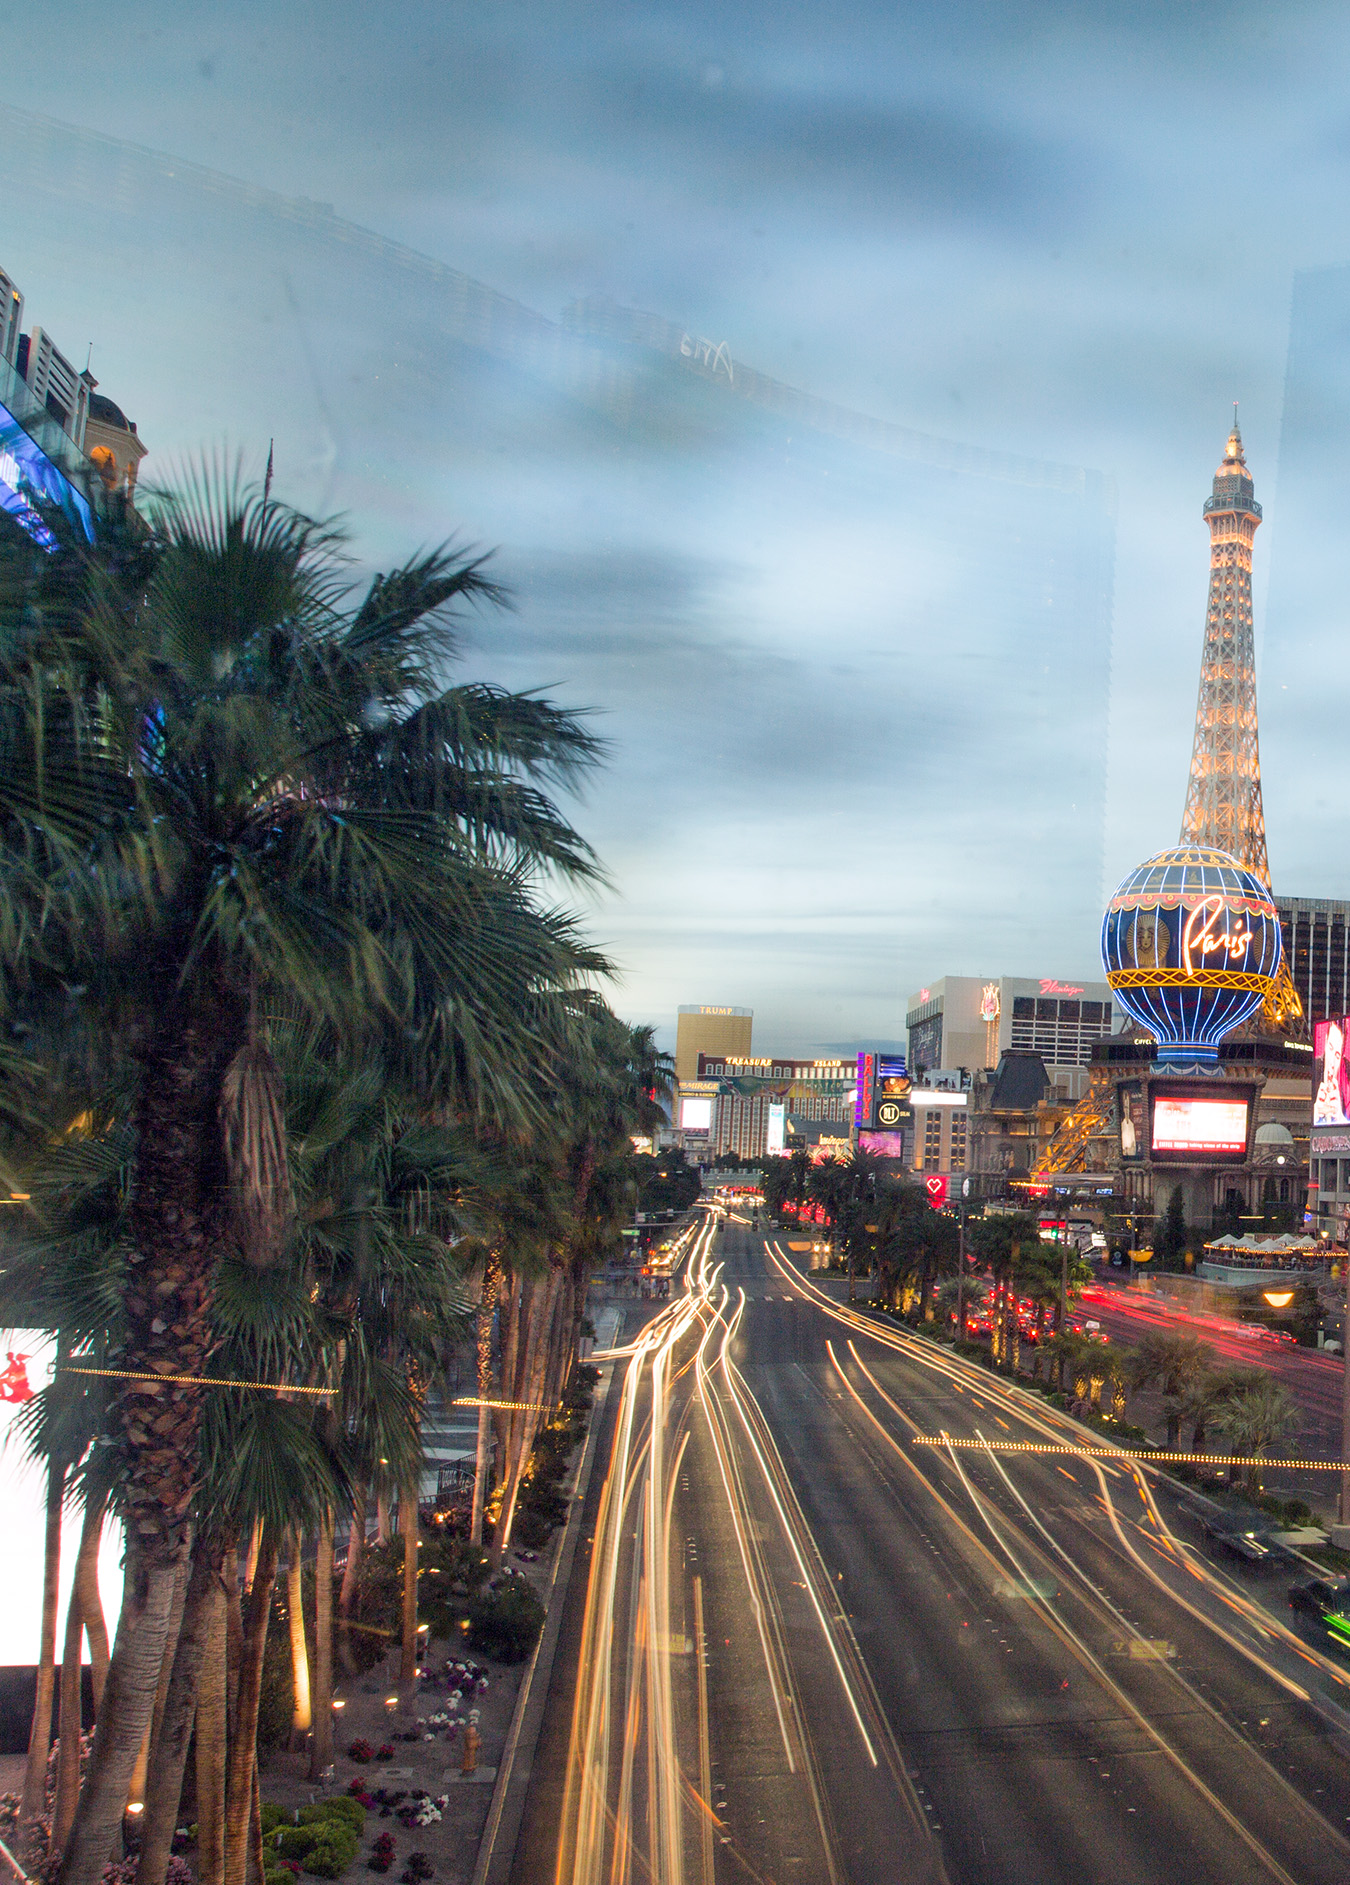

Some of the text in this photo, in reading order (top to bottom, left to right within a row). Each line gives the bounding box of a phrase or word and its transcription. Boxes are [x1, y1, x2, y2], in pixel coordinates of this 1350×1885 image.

[1183, 894, 1254, 977] Paris
[1039, 979, 1085, 997] Flamingo
[700, 1006, 733, 1016] TRUMP
[725, 1056, 842, 1068] TREASURE ISLAND
[686, 1081, 719, 1090] MIRAGE
